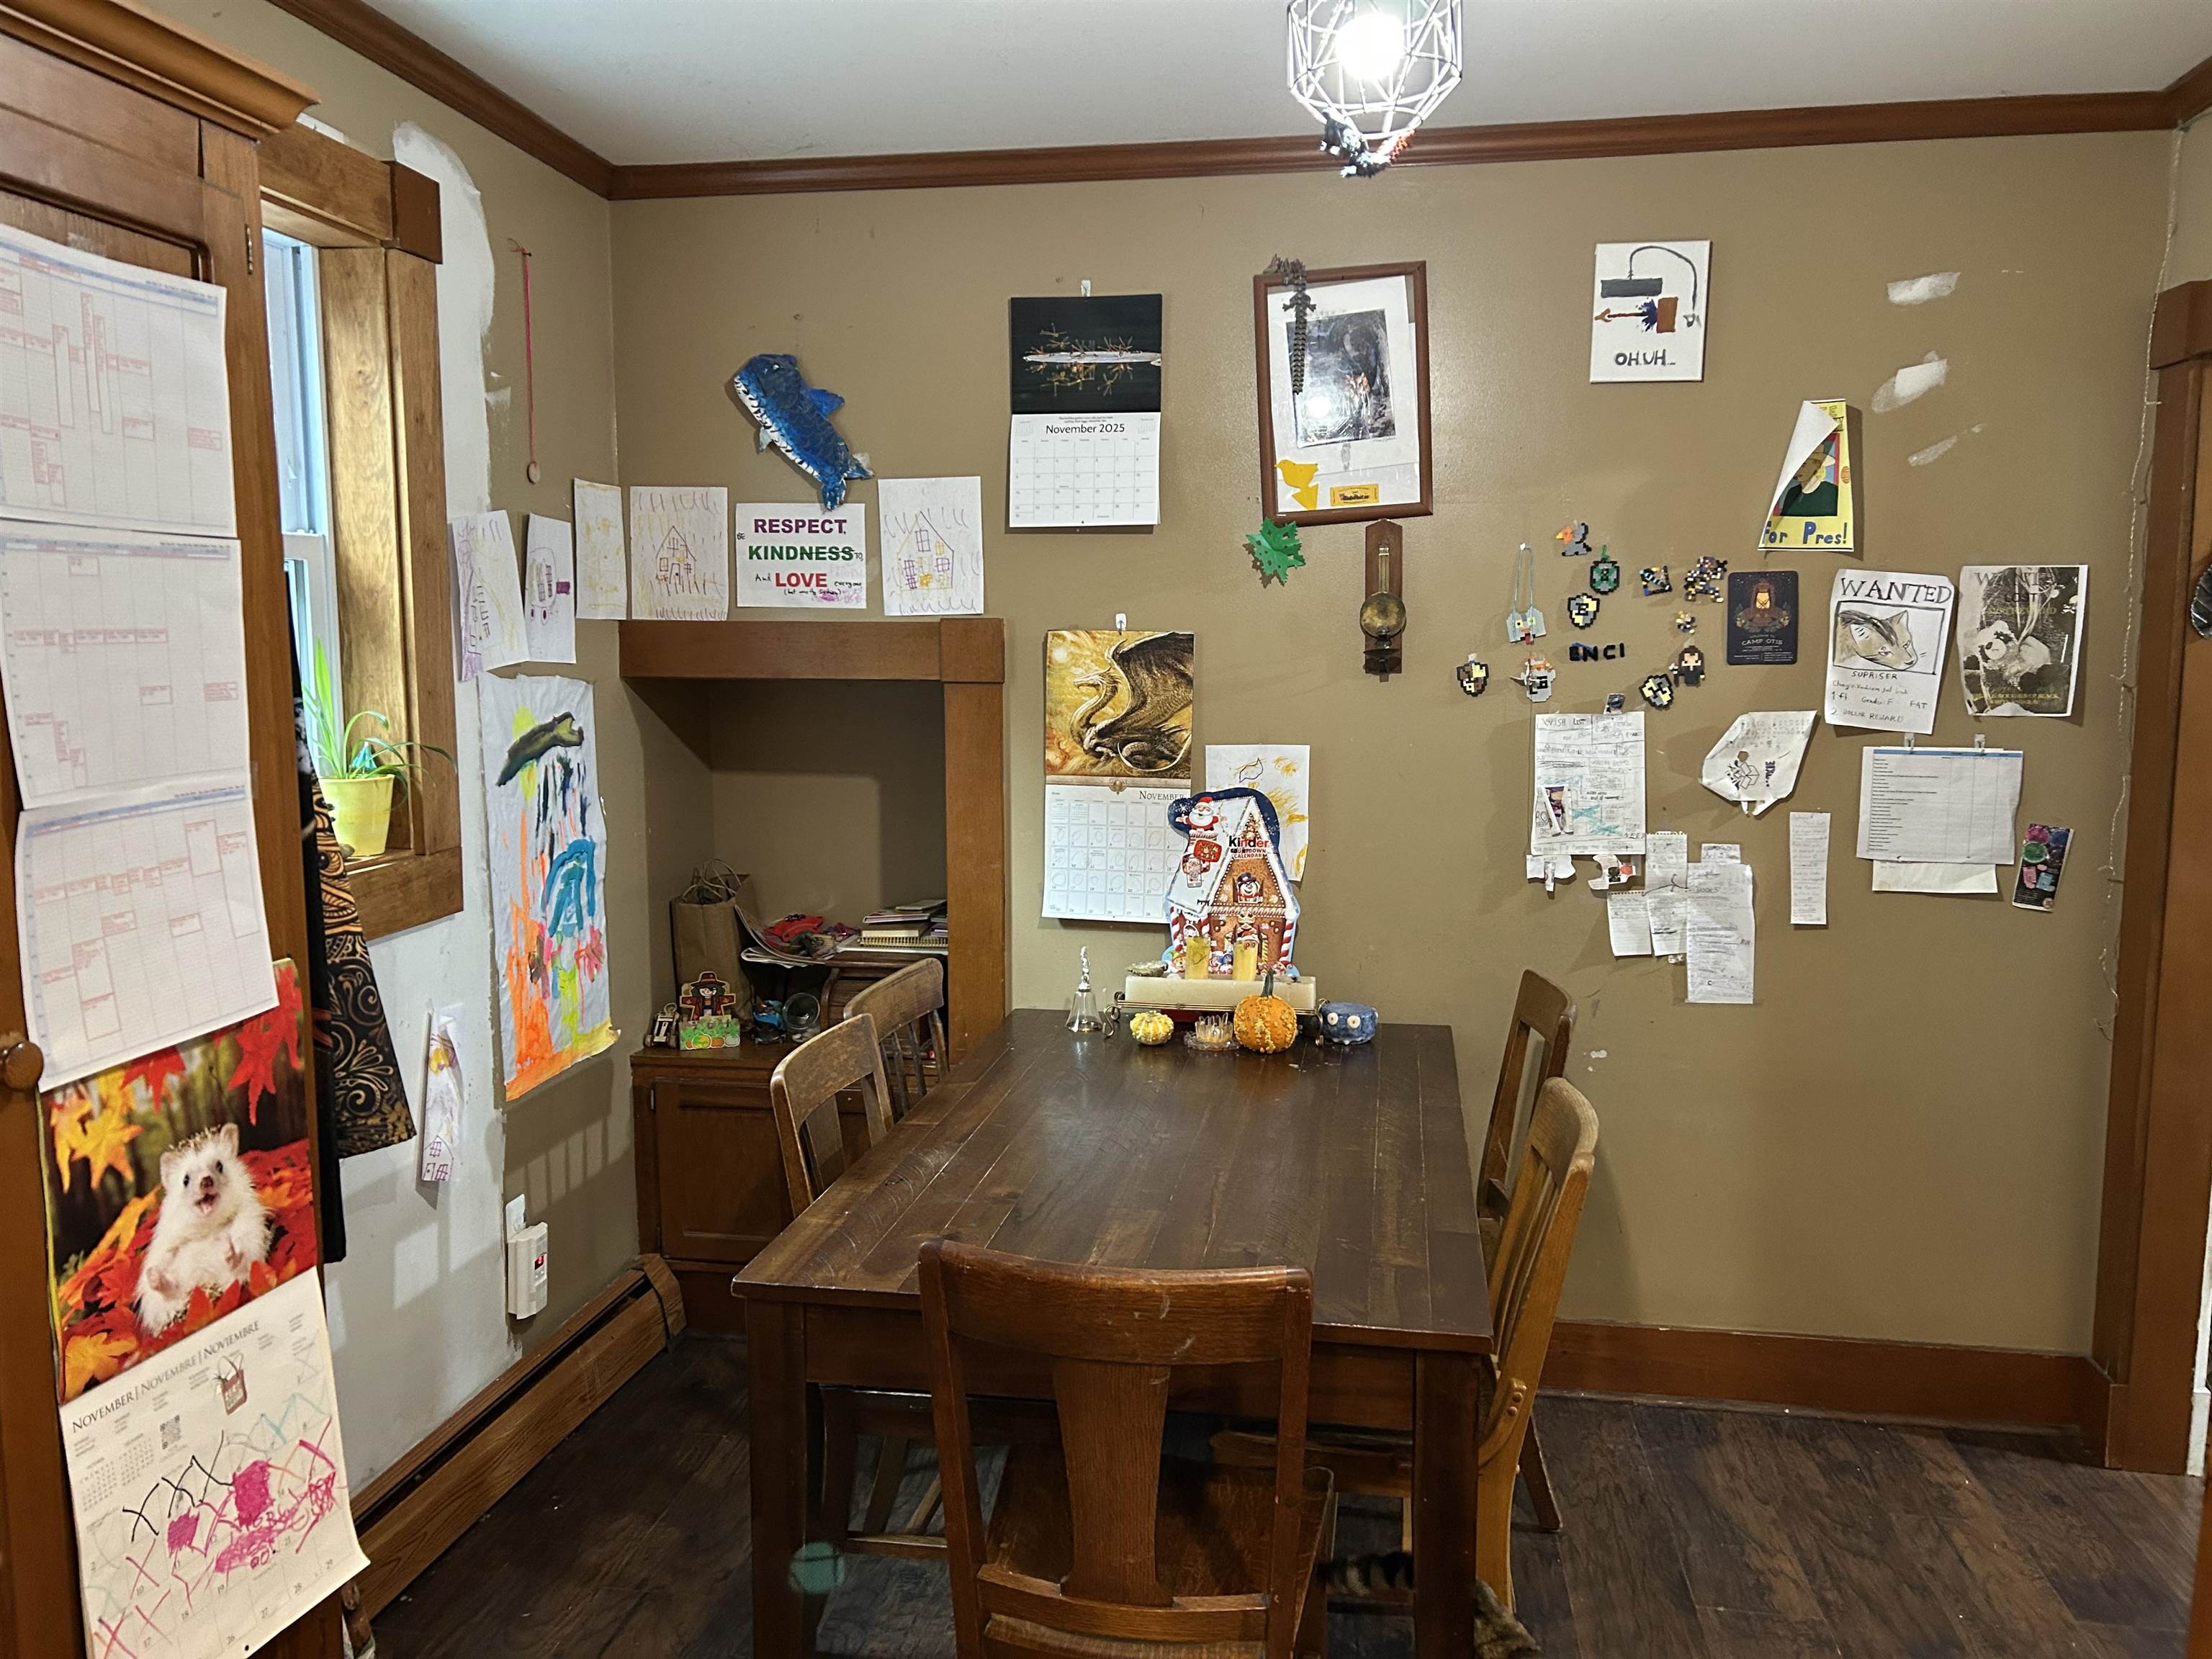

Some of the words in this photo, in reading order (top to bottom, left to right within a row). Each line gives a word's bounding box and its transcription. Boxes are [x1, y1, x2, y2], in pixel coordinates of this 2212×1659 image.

[1046, 423, 1097, 434] November
[1100, 423, 1125, 433] 2025
[1803, 521, 1848, 545] Pres!
[748, 546, 855, 561] KINDNESS
[755, 572, 772, 583] And
[775, 572, 827, 588] LOVE
[1840, 577, 1953, 604] WANTED
[1910, 700, 1928, 709] FAT
[1542, 718, 1566, 727] WISH
[1228, 835, 1269, 848] kinder
[71, 1391, 135, 1434] NOVEMBER
[140, 1354, 198, 1393] NOVEMBRE
[202, 1320, 260, 1358] NOVIEMBRE
